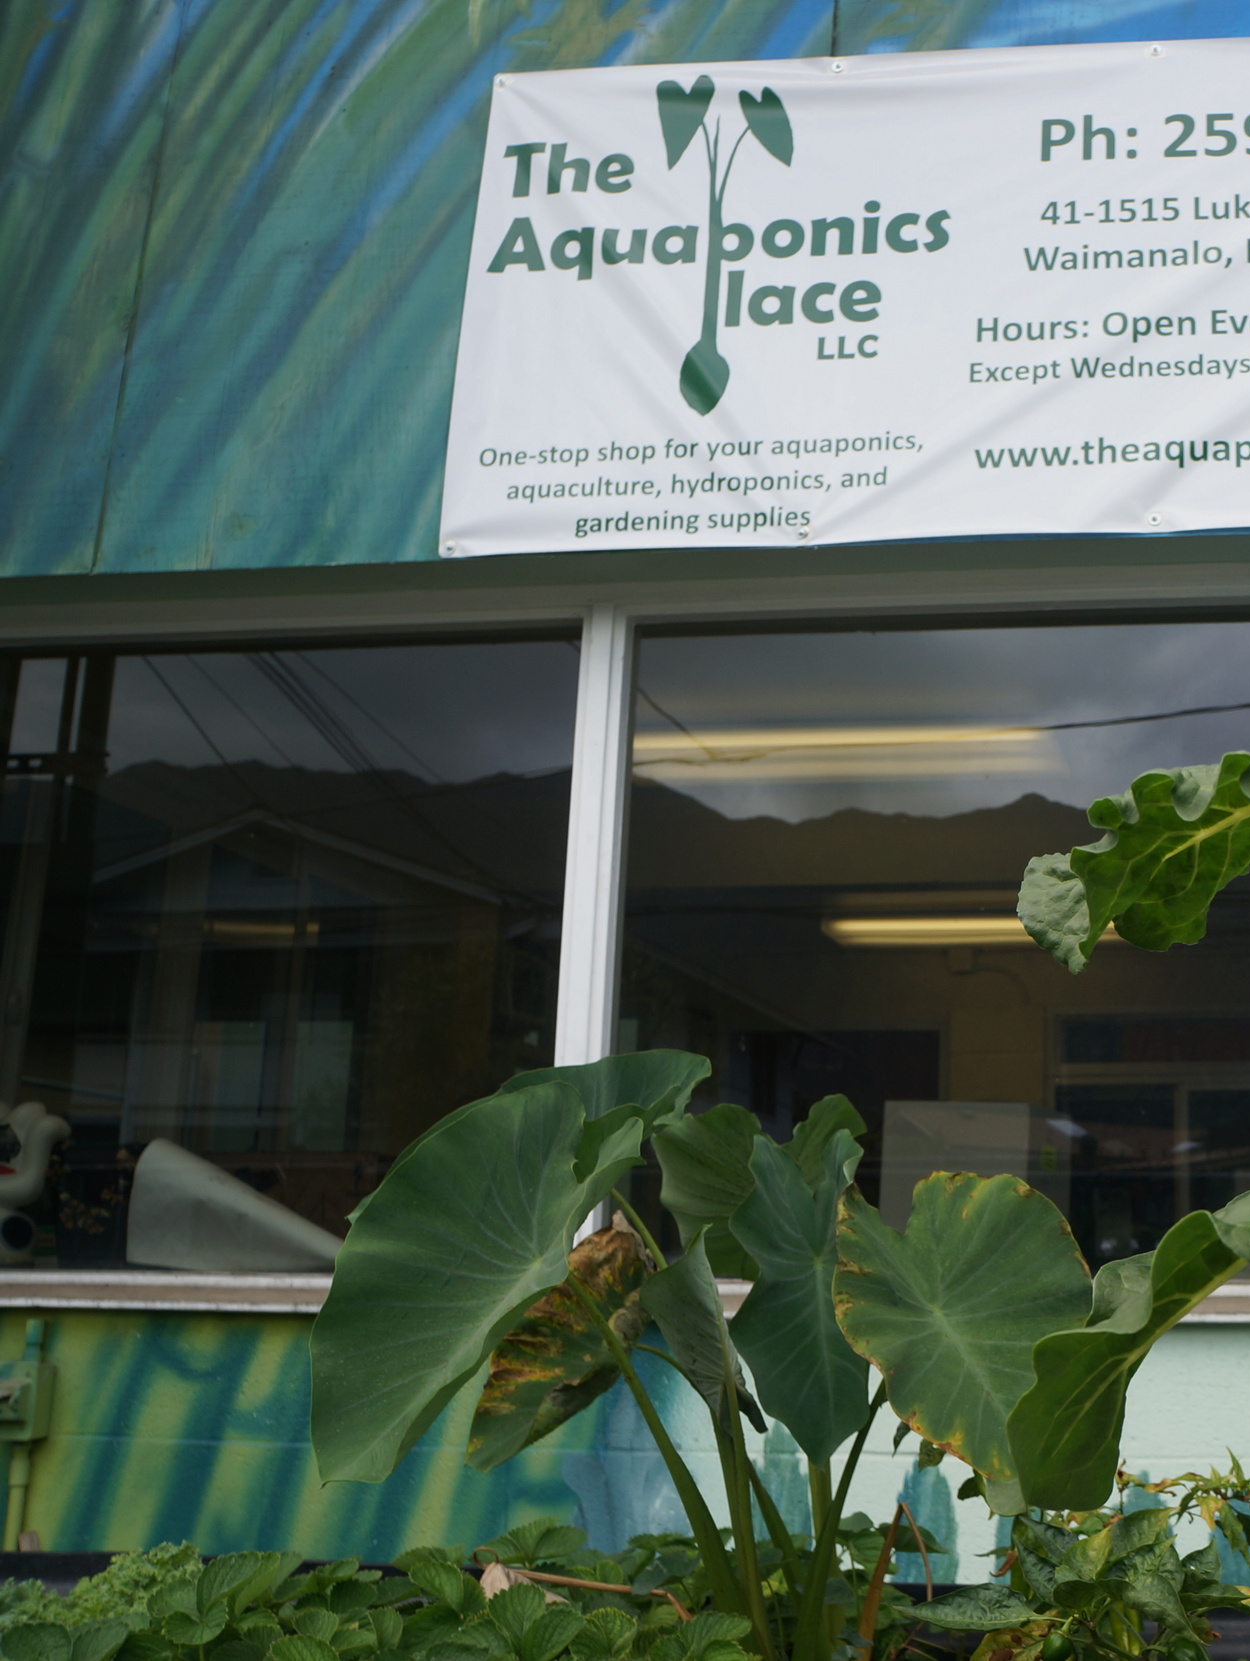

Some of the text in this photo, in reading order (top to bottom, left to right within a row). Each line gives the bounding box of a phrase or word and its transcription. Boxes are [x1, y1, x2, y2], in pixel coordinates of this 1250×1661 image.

[1041, 114, 1137, 161] Ph:
[504, 142, 634, 197] The
[1041, 197, 1180, 225] 41-1515
[487, 200, 951, 280] Aquaponics
[1024, 240, 1232, 271] Waimanalo,
[977, 317, 1088, 342] Hours:
[1103, 312, 1196, 343] Open
[817, 334, 879, 360] LLC
[970, 360, 1060, 384] Except
[1071, 354, 1250, 379] Wednesdays
[479, 431, 922, 467] One-stop shop for your aquaponics,
[507, 466, 887, 503] aquaculture, hydroponics, and
[575, 506, 810, 537] gardening supplies
